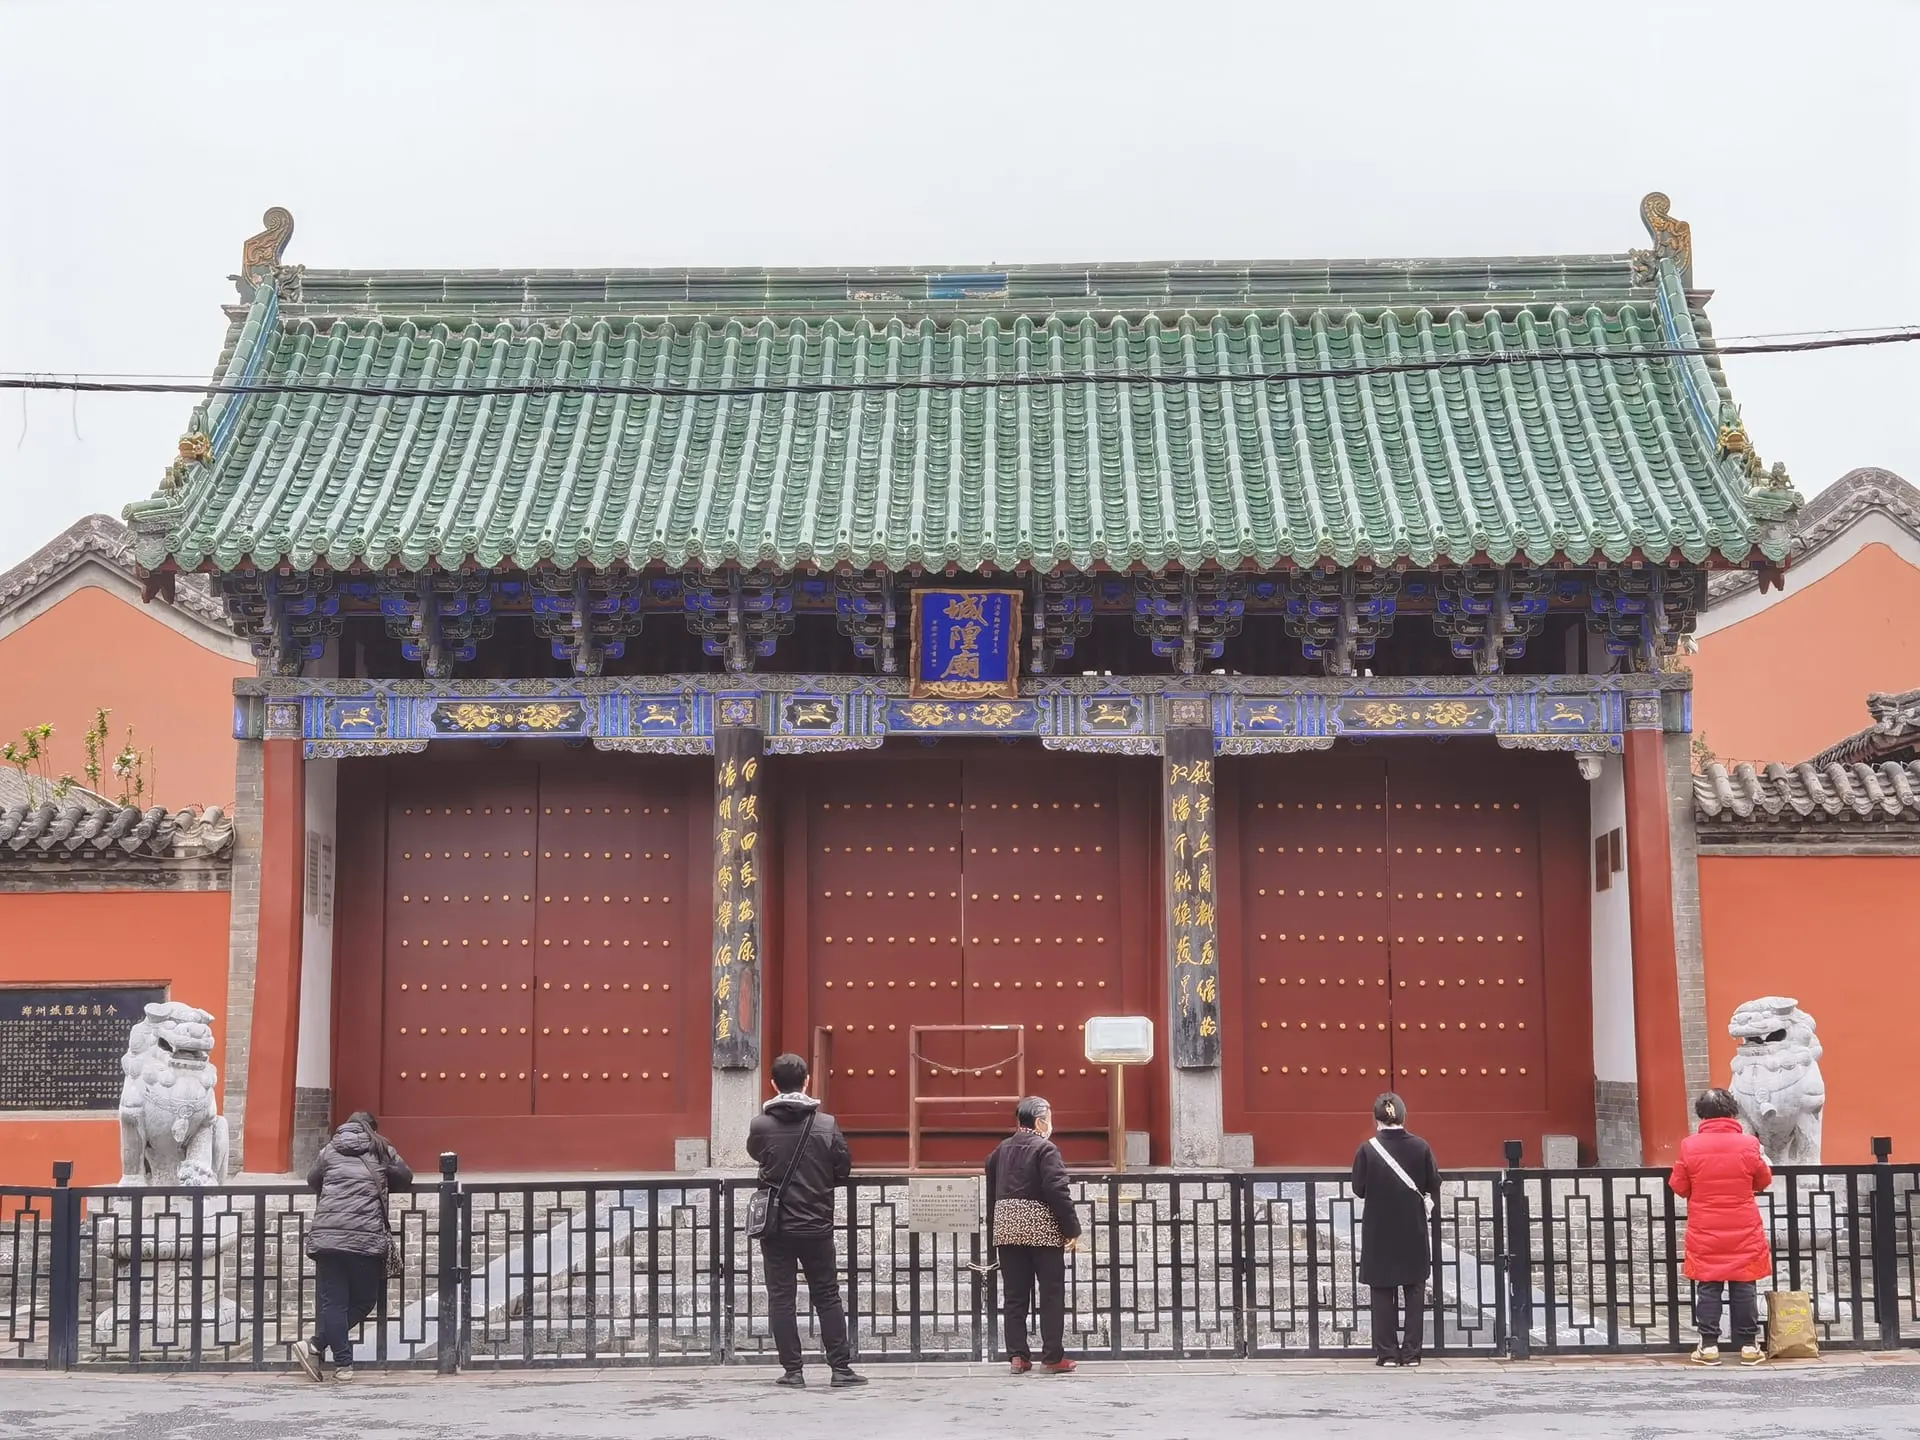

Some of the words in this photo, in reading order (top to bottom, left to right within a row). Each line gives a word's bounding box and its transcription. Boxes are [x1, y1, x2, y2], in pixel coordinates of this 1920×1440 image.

[21, 1004, 118, 1017] 郑州城隍庙简介
